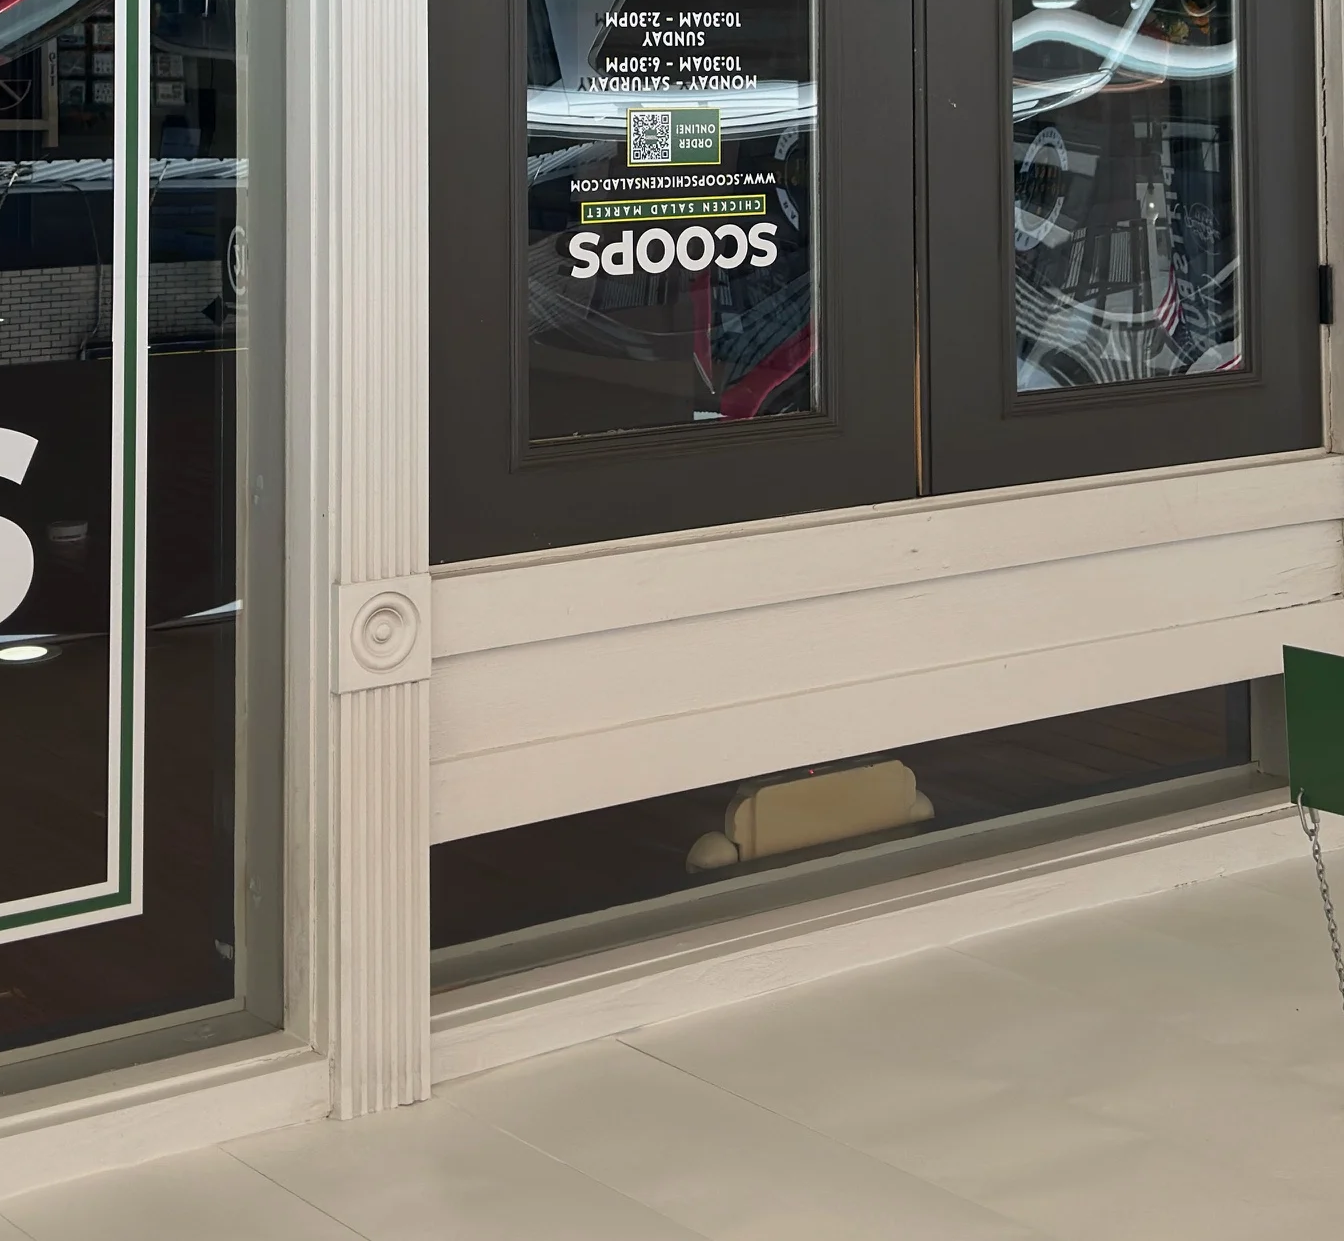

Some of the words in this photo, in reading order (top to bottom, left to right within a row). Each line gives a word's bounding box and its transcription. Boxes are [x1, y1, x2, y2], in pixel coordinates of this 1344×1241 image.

[605, 11, 661, 27] 2:30PM
[679, 11, 741, 27] 10:30AM
[641, 31, 705, 47] SUNDAY
[605, 56, 661, 72] 6:30PM
[679, 56, 741, 72] 10:30AM
[588, 76, 671, 92] SATURDAY
[690, 74, 758, 90] MONDAY
[676, 123, 716, 135] ONLINE!
[678, 138, 713, 149] ORDER
[570, 172, 776, 192] WWW.SCOOPSCHICKENSALAD.COM
[586, 205, 642, 219] MARKET
[650, 202, 694, 215] SALAD
[702, 199, 761, 214] CHICKEN
[568, 222, 778, 279] SCOOPS
